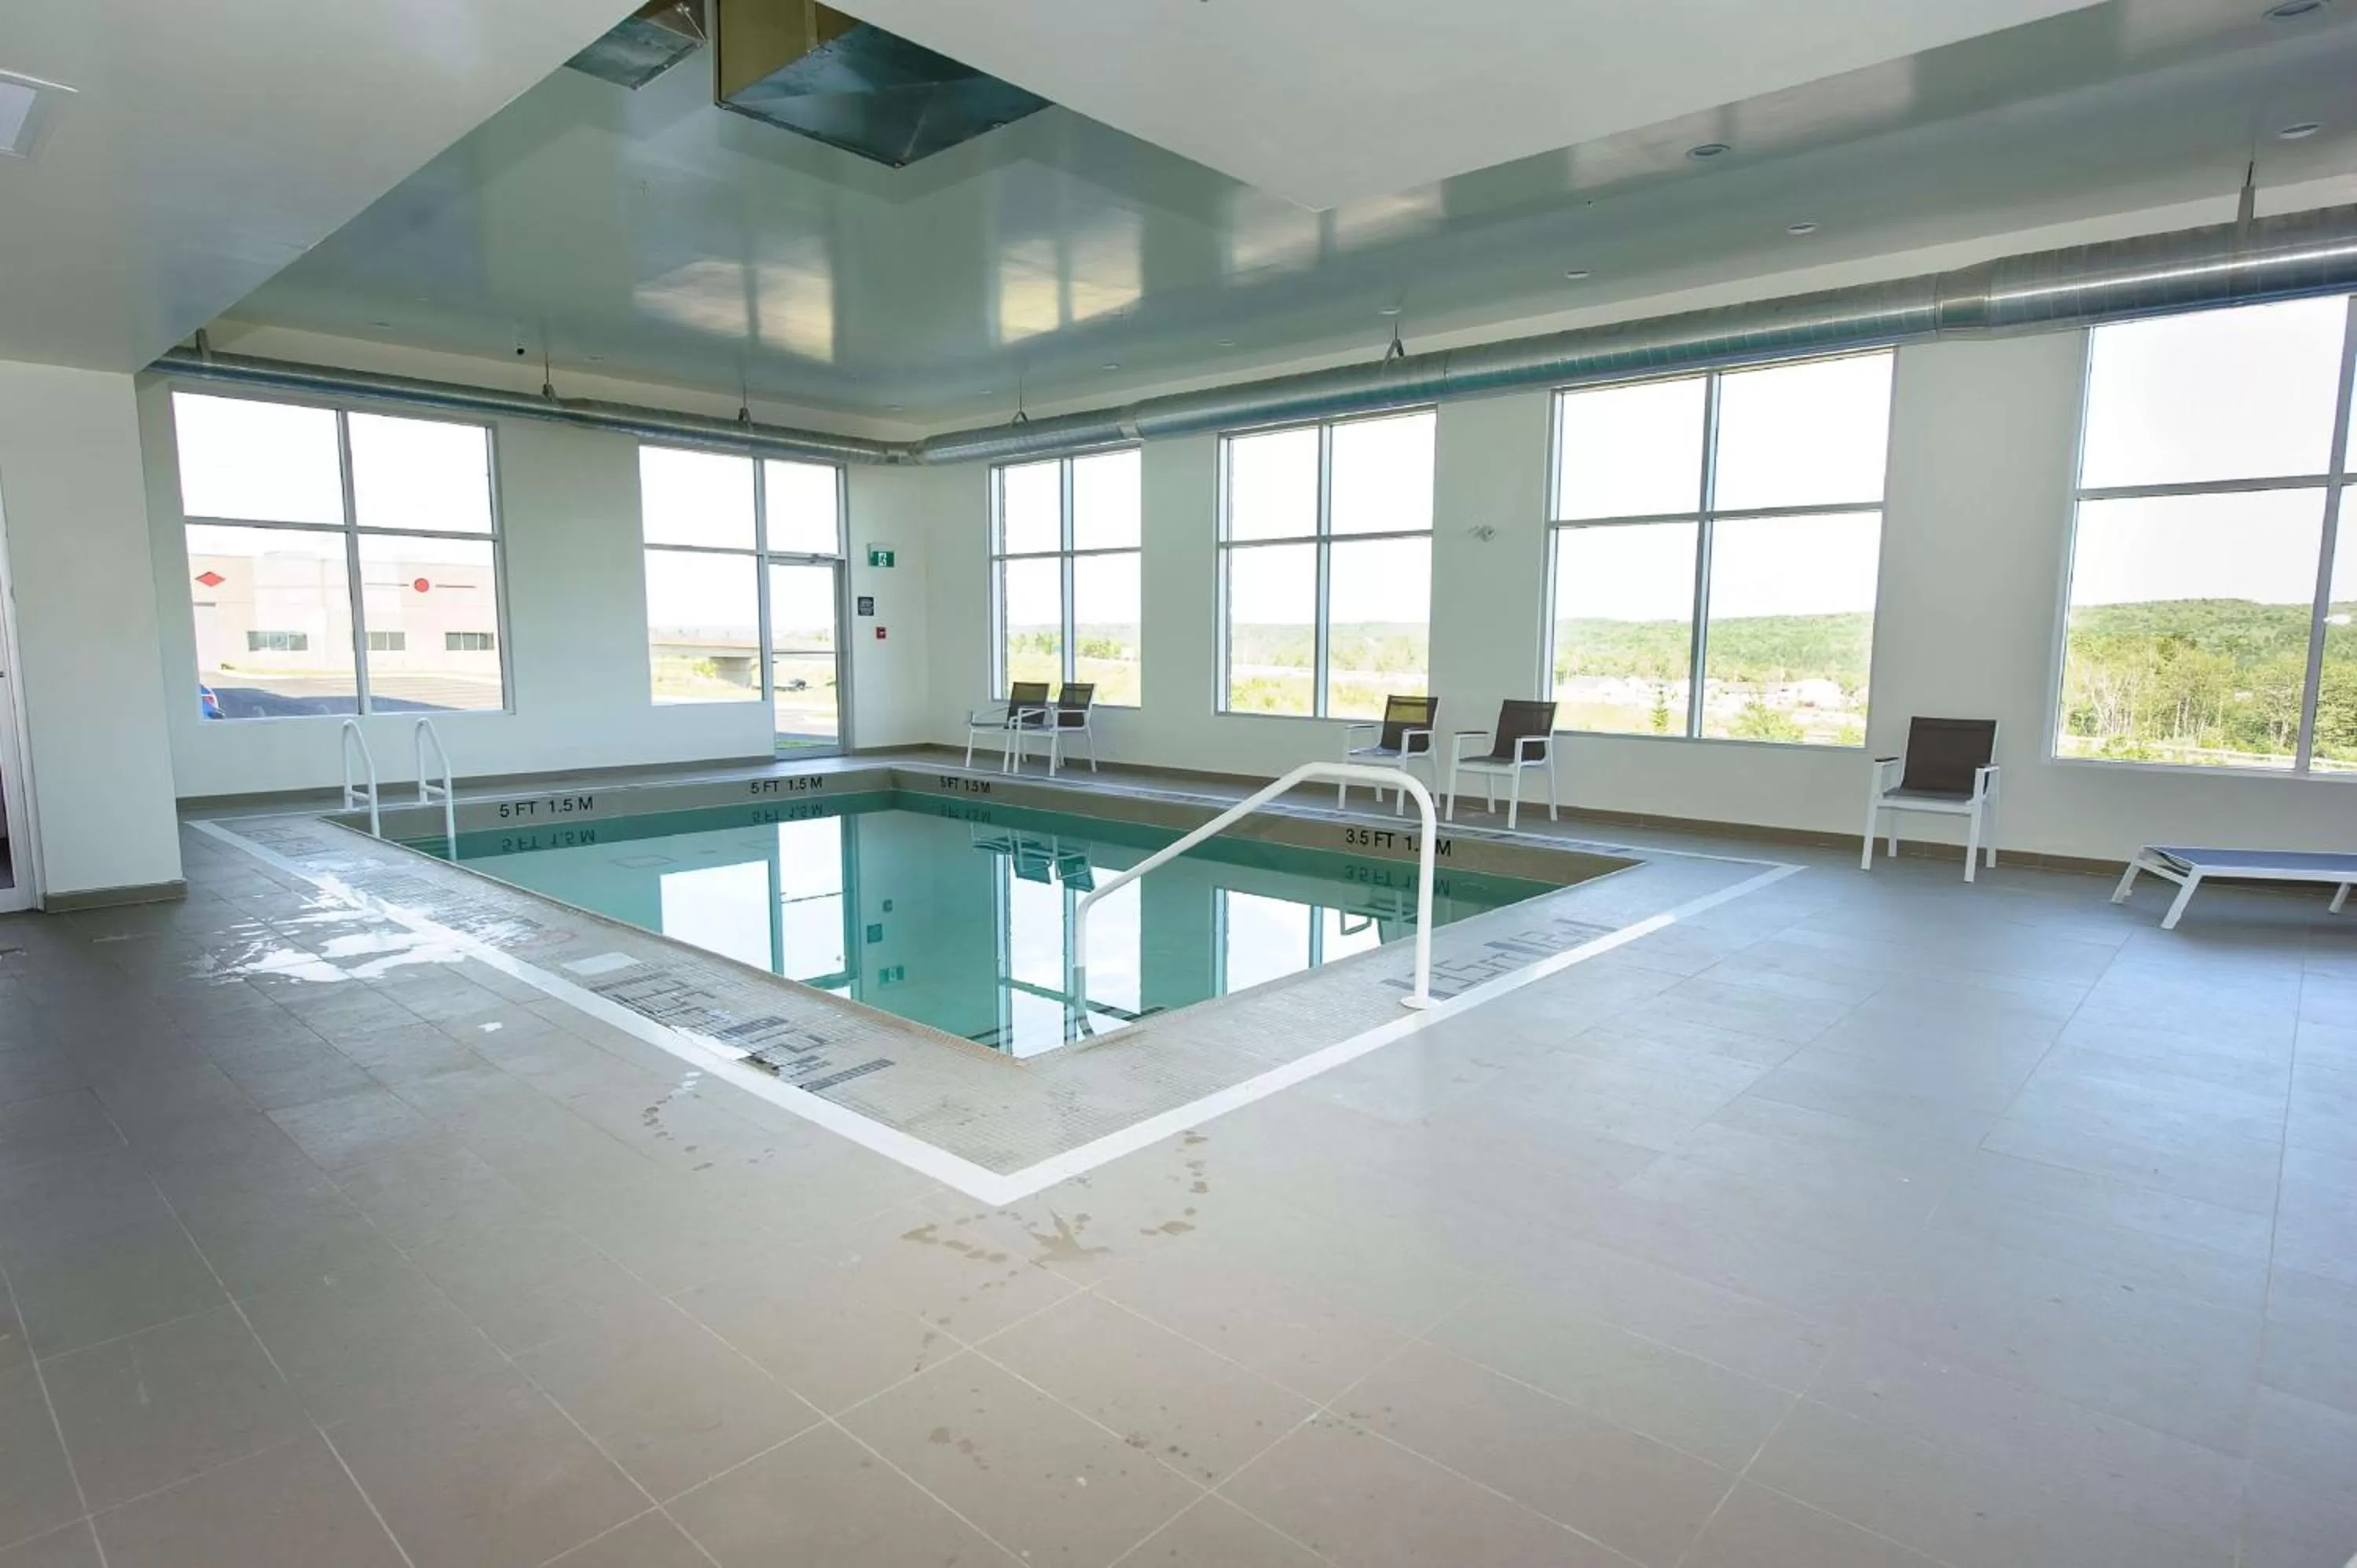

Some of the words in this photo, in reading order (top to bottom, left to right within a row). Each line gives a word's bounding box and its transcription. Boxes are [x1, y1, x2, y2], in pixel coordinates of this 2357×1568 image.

[750, 781, 760, 795] 5
[763, 780, 780, 793] FT
[787, 777, 807, 792] 1.5
[810, 775, 823, 789] M
[948, 777, 959, 790] FT
[981, 781, 992, 794] M
[499, 803, 510, 818] 5
[515, 800, 538, 816] FT
[548, 797, 573, 813] 1.5
[578, 796, 593, 811] M
[1346, 828, 1369, 846] 3.5
[1374, 830, 1395, 849] FT
[1404, 835, 1422, 853] 1.
[1435, 838, 1452, 857] M
